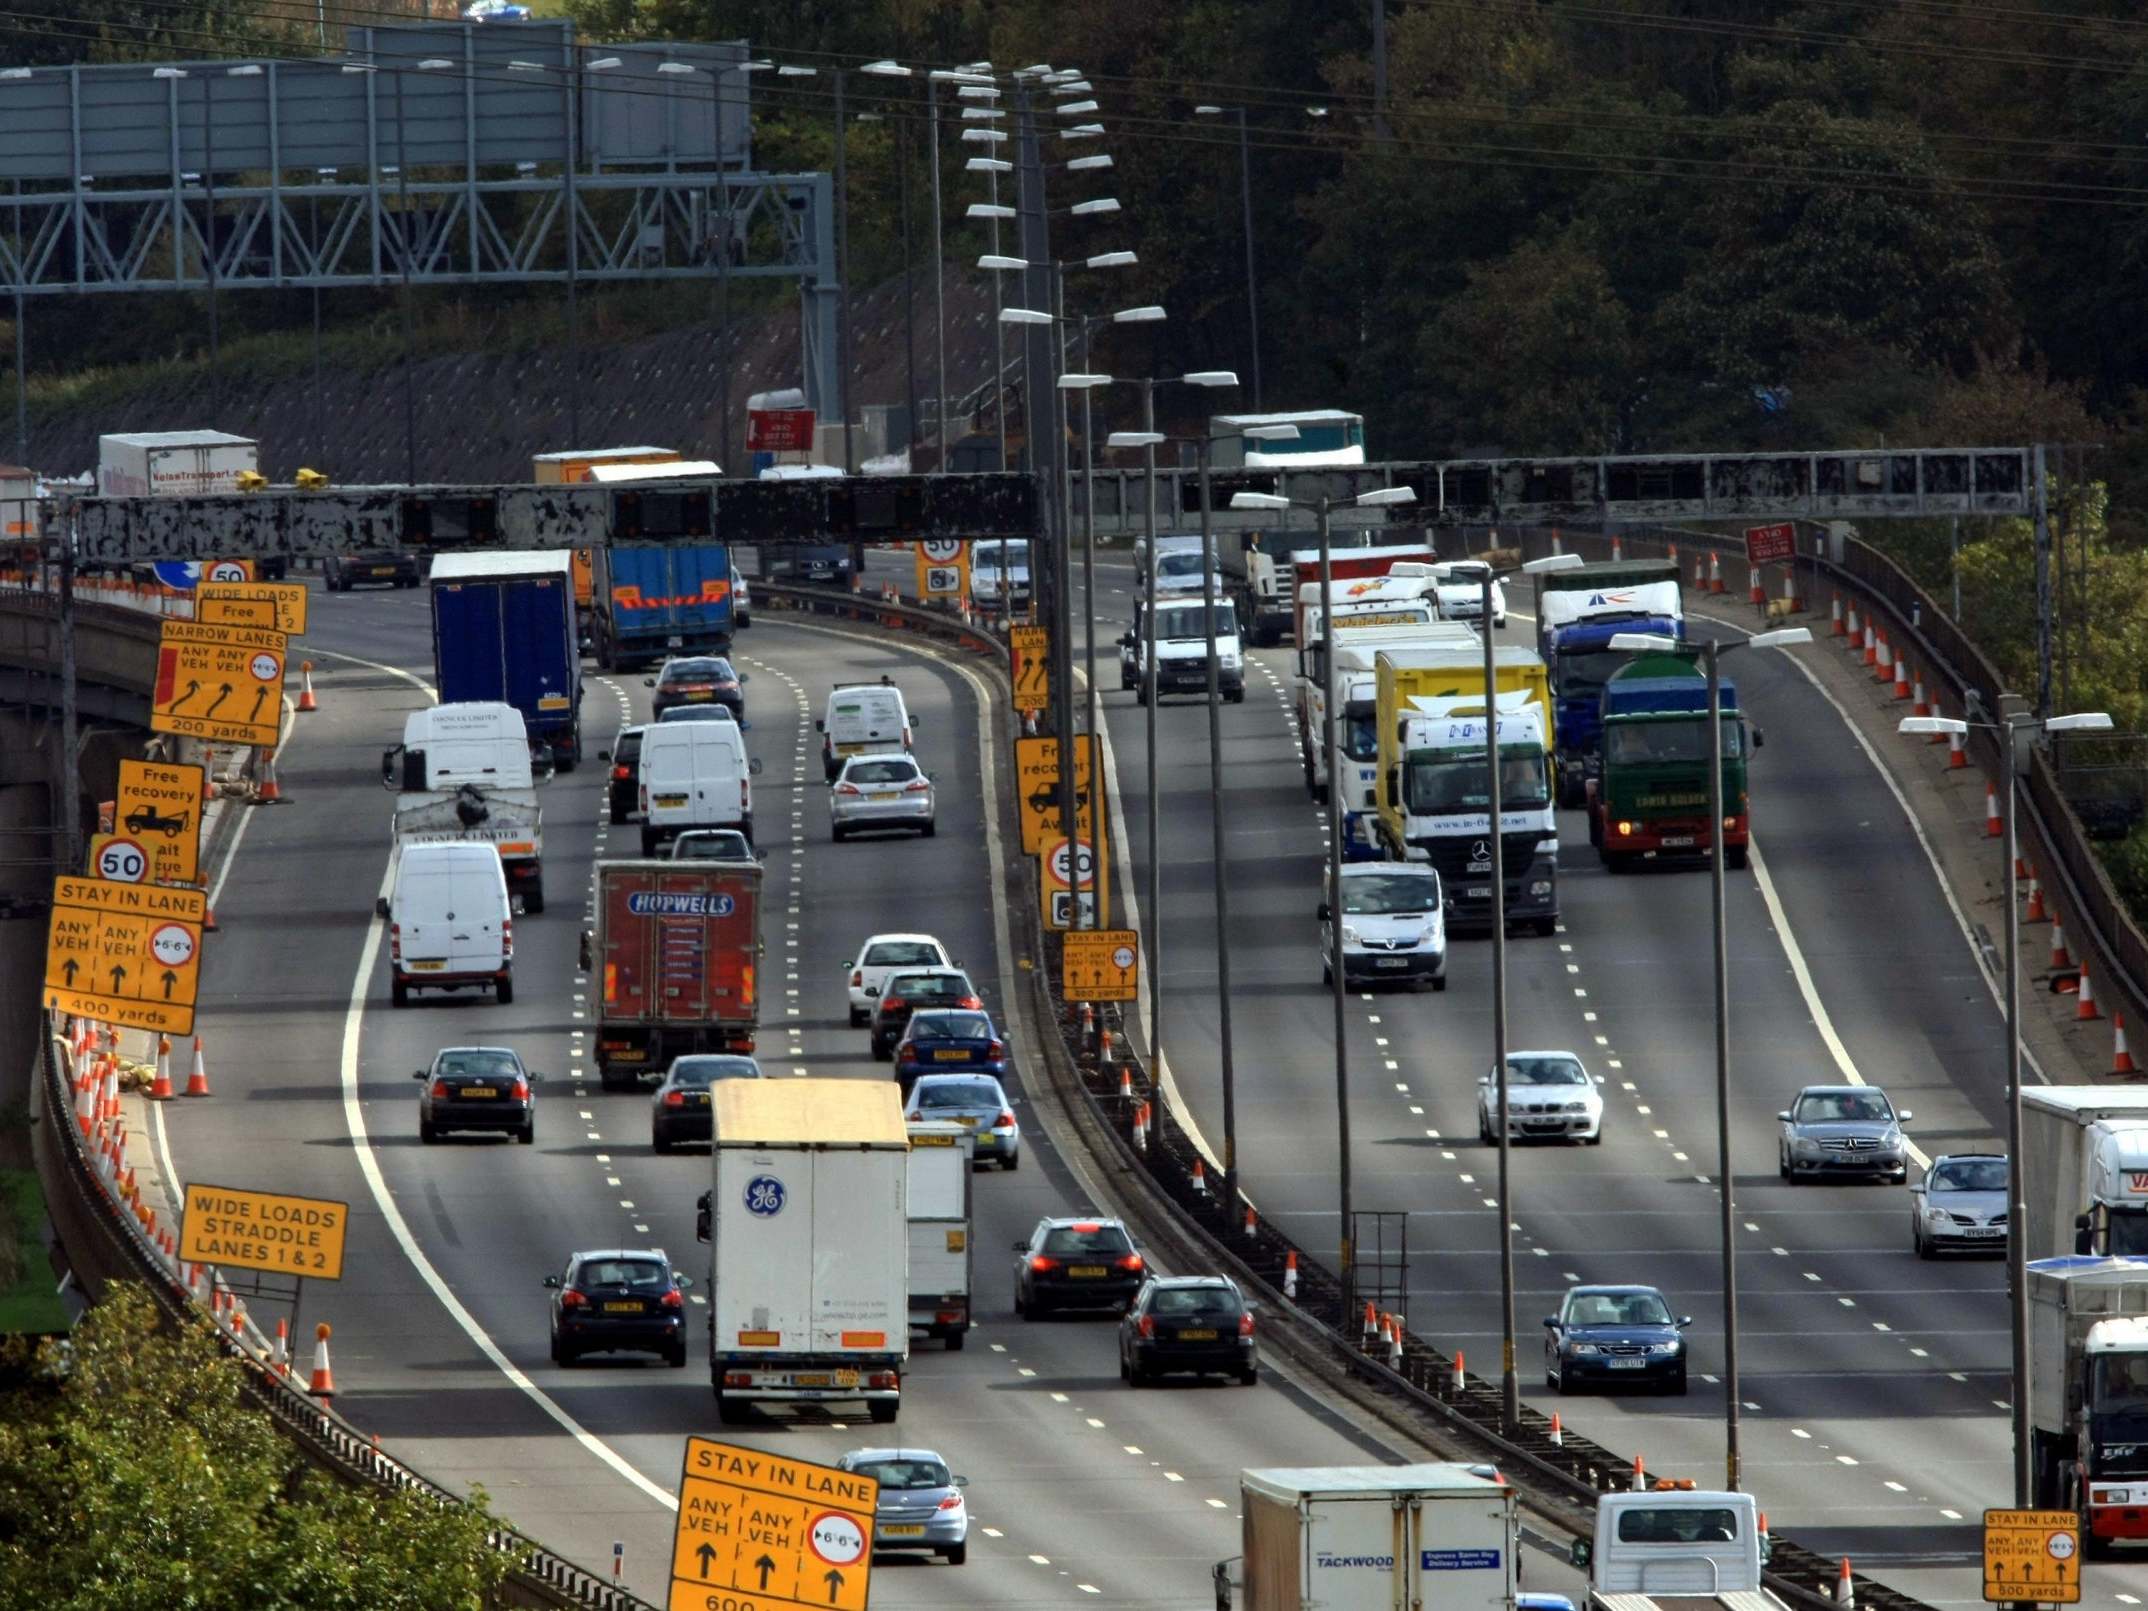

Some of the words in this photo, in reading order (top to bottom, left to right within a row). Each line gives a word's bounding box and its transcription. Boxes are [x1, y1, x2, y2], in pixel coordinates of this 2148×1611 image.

[202, 588, 240, 600] WIDE
[247, 590, 299, 601] LOADS
[223, 605, 254, 617] Free
[165, 624, 230, 641] NARROW
[236, 632, 284, 647] LANES
[182, 646, 210, 657] ANY
[216, 648, 247, 660] ANY
[181, 658, 208, 669] VEH
[216, 660, 244, 672] VEH
[172, 719, 204, 733] 200
[212, 722, 257, 739] yards
[143, 768, 179, 783] Free
[124, 785, 195, 802] recovery
[103, 853, 141, 876] 50
[1059, 854, 1092, 873] 50
[62, 884, 112, 902] STAY
[119, 891, 140, 906] IN
[148, 895, 200, 914] LANE
[635, 894, 729, 914] HOPWELLS
[57, 920, 91, 933] ANY
[105, 927, 138, 941] ANY
[56, 936, 89, 950] VEH
[104, 942, 136, 956] VEH
[72, 999, 109, 1015] 400
[117, 1009, 166, 1025] yards
[195, 1196, 251, 1217] WIDE
[261, 1204, 336, 1228] LOADS
[204, 1217, 320, 1247] STRADDLE
[195, 1237, 269, 1261] LANES
[278, 1248, 285, 1263] 1
[293, 1251, 306, 1266] &
[313, 1252, 326, 1269] 2
[698, 1449, 760, 1478] STAY
[770, 1465, 795, 1486] IN
[806, 1473, 870, 1502] LANE
[689, 1497, 732, 1516] ANY
[750, 1510, 794, 1530] ANY
[1988, 1514, 2019, 1525] STAY
[2024, 1515, 2038, 1525] IN
[2043, 1515, 2077, 1525] LANE
[688, 1515, 728, 1536] VEH
[750, 1528, 789, 1549] VEH
[1988, 1537, 2010, 1545] ANY
[2017, 1537, 2039, 1546] ANY
[1988, 1547, 2010, 1555] VEH
[2018, 1547, 2040, 1555] VEH
[1317, 1555, 1394, 1568] TACKWOOD
[1460, 1559, 1490, 1567] Service
[2030, 1585, 2065, 1597] yards
[706, 1595, 754, 1611] 600
